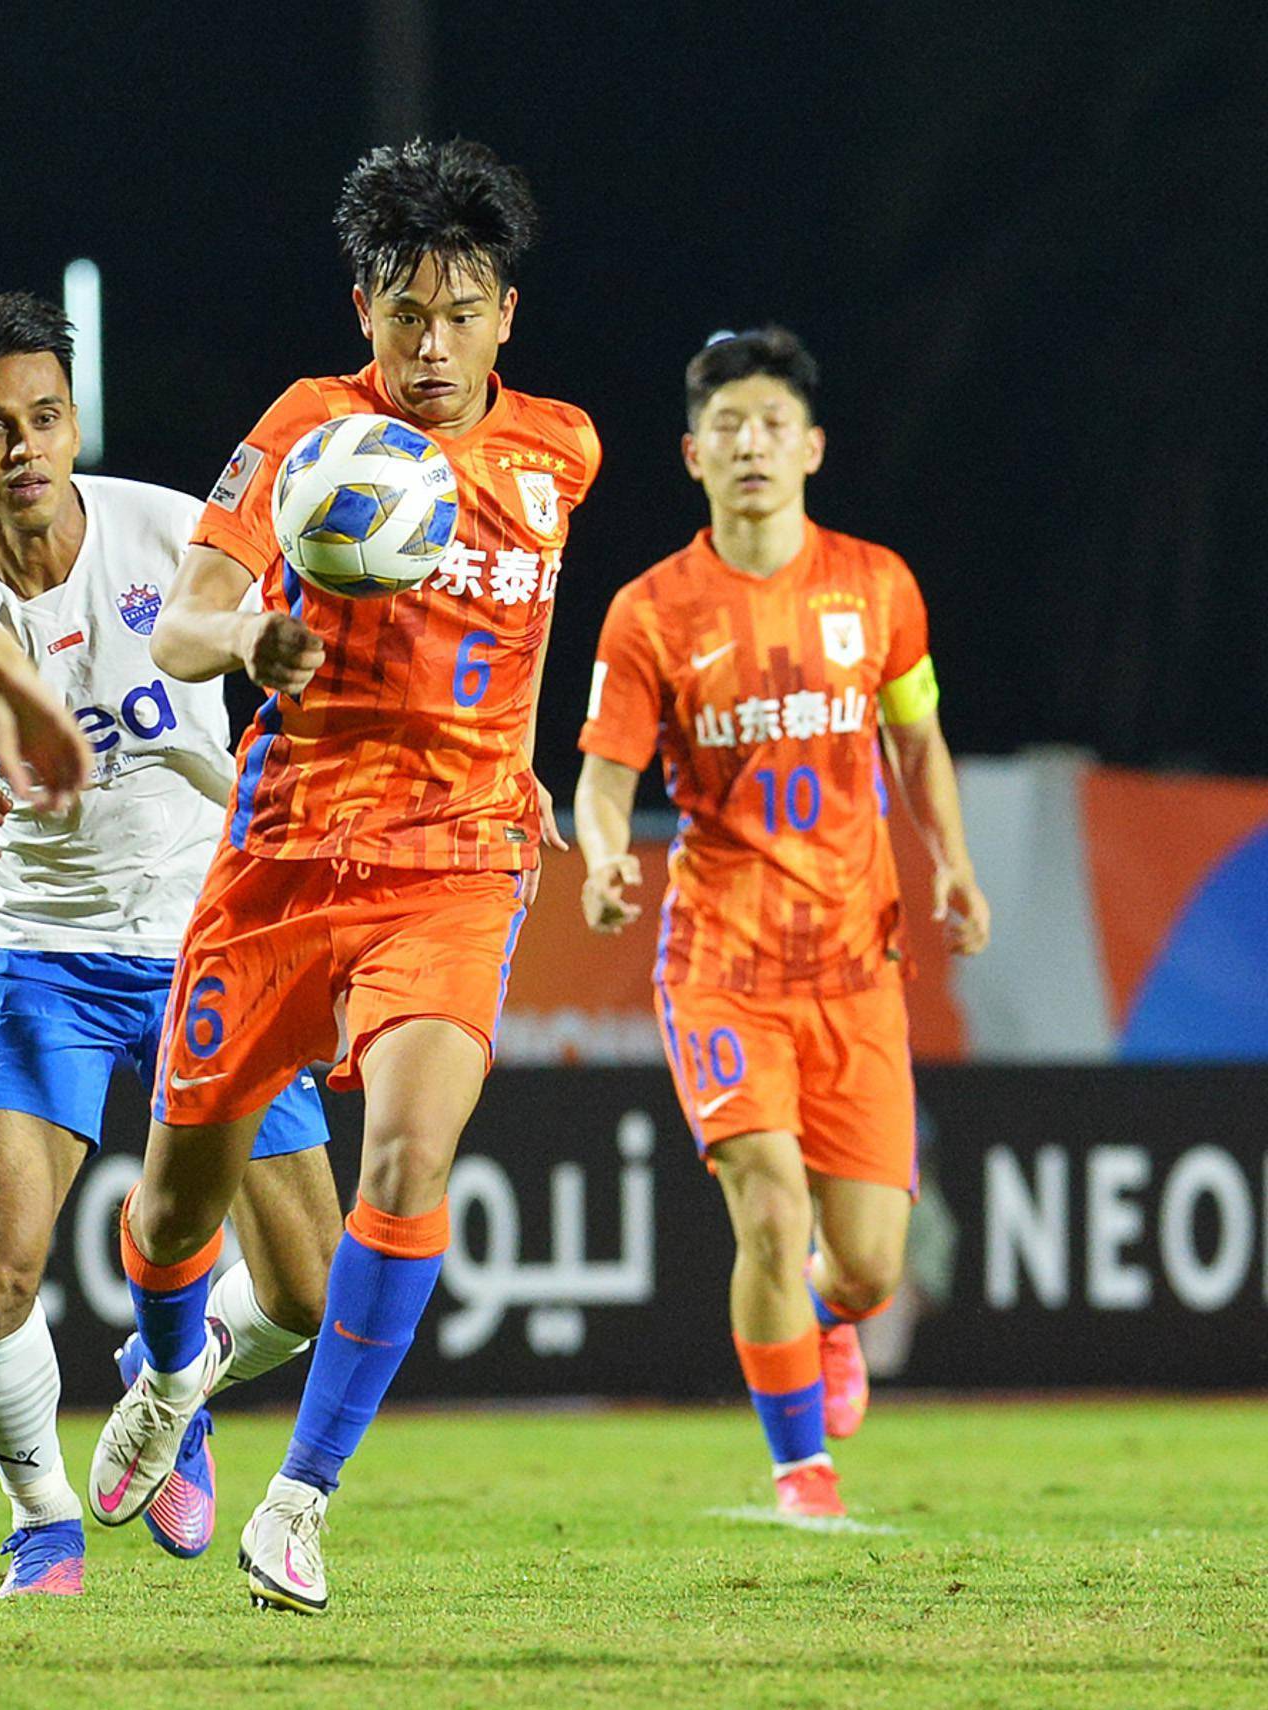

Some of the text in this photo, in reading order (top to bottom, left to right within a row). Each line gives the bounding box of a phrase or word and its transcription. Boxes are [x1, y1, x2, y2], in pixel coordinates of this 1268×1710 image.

[411, 540, 562, 605] 东泰山
[452, 630, 497, 708] 6
[73, 680, 178, 753] ea
[695, 686, 867, 748] 山东泰山
[755, 765, 821, 834] 10
[184, 976, 224, 1059] 6
[688, 1026, 745, 1091] 10
[983, 1143, 1268, 1312] NEO
